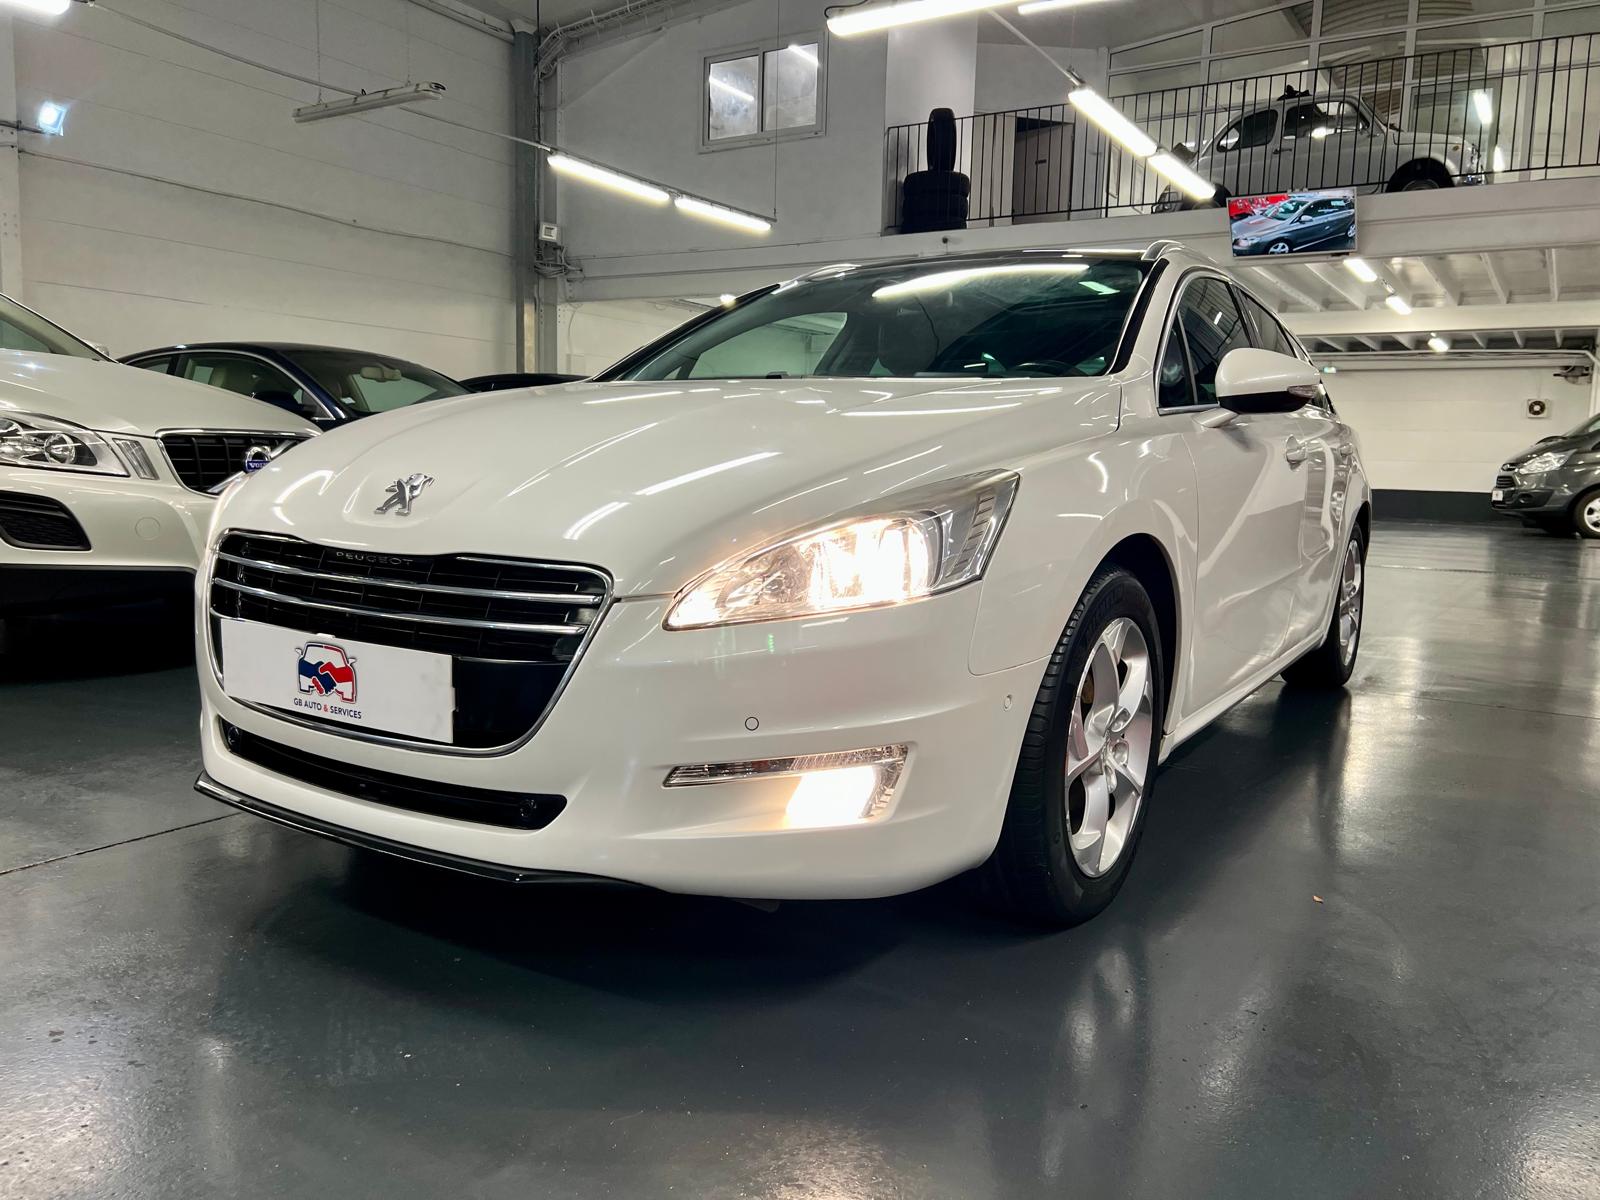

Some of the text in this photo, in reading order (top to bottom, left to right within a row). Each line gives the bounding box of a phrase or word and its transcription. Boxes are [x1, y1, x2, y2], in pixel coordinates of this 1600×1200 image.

[336, 551, 414, 566] PEUGEOT
[293, 697, 362, 719] GB AUTO & SERVICES
